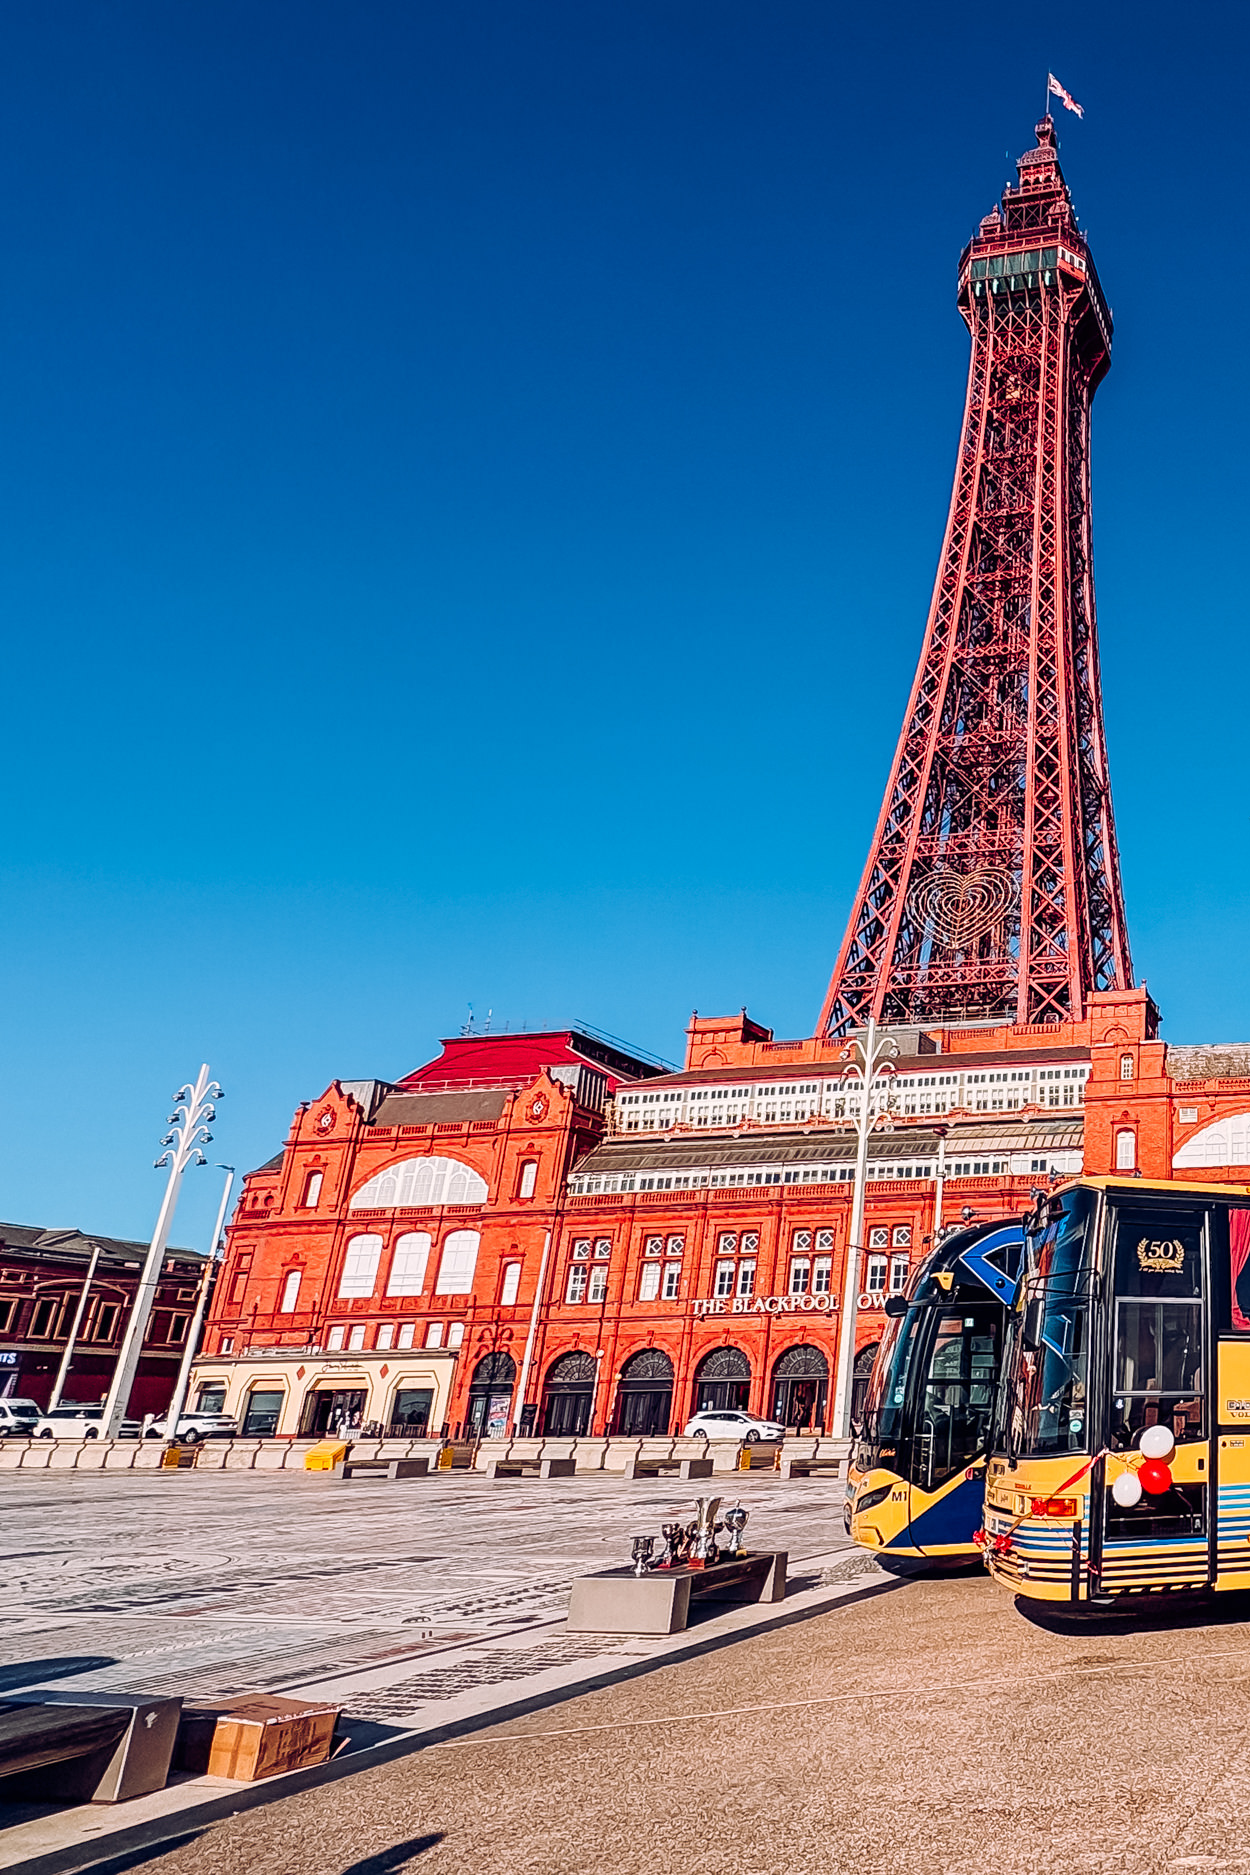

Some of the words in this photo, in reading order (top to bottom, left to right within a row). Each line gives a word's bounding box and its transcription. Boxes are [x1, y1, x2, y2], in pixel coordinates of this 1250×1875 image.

[1148, 1241, 1174, 1258] 50
[691, 1299, 727, 1315] THE
[731, 1294, 840, 1314] BLACKPOOL
[891, 1490, 908, 1502] M1
